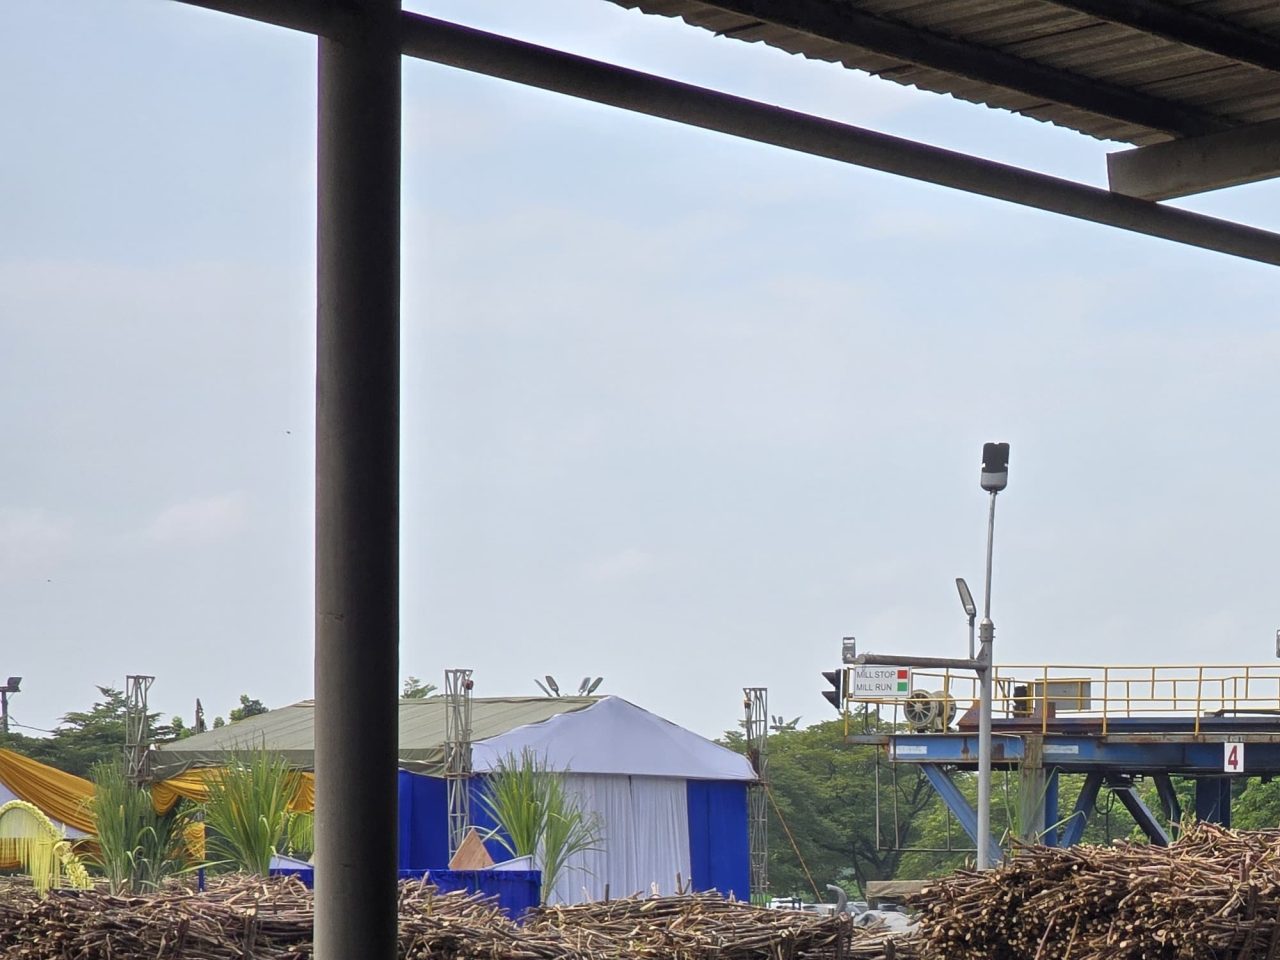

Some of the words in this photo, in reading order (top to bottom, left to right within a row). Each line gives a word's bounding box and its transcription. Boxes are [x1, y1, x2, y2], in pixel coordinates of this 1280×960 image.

[856, 670, 873, 679] MILL
[874, 670, 896, 679] STOP
[856, 683, 873, 691] MILL
[875, 683, 892, 691] RUN
[1227, 745, 1239, 770] 4
